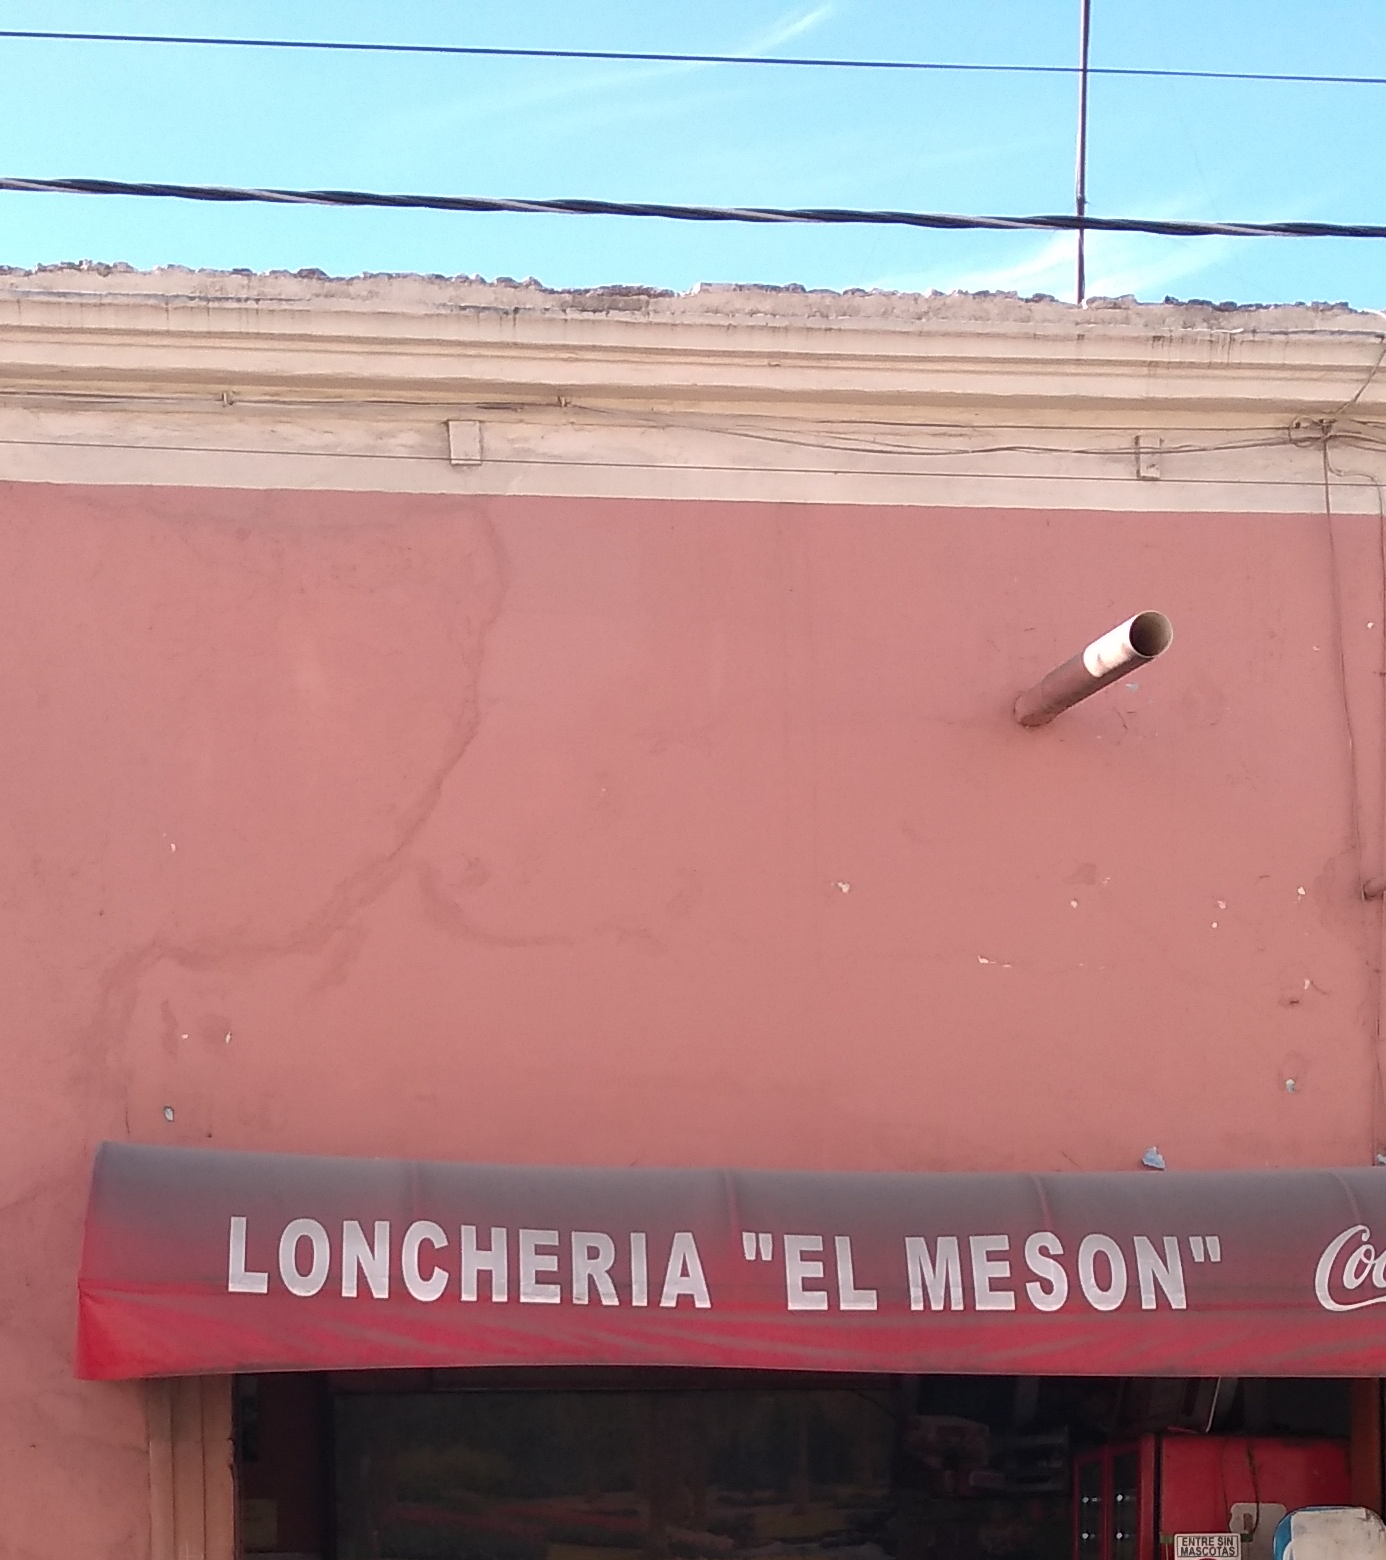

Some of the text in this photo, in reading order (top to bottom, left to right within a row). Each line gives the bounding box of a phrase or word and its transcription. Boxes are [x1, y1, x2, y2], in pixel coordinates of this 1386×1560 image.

[228, 1215, 1223, 1312] LONCHERIA "EL MESON"
[1182, 1537, 1233, 1547] ENTRE SIN
[1180, 1546, 1236, 1557] MASCOTAS
